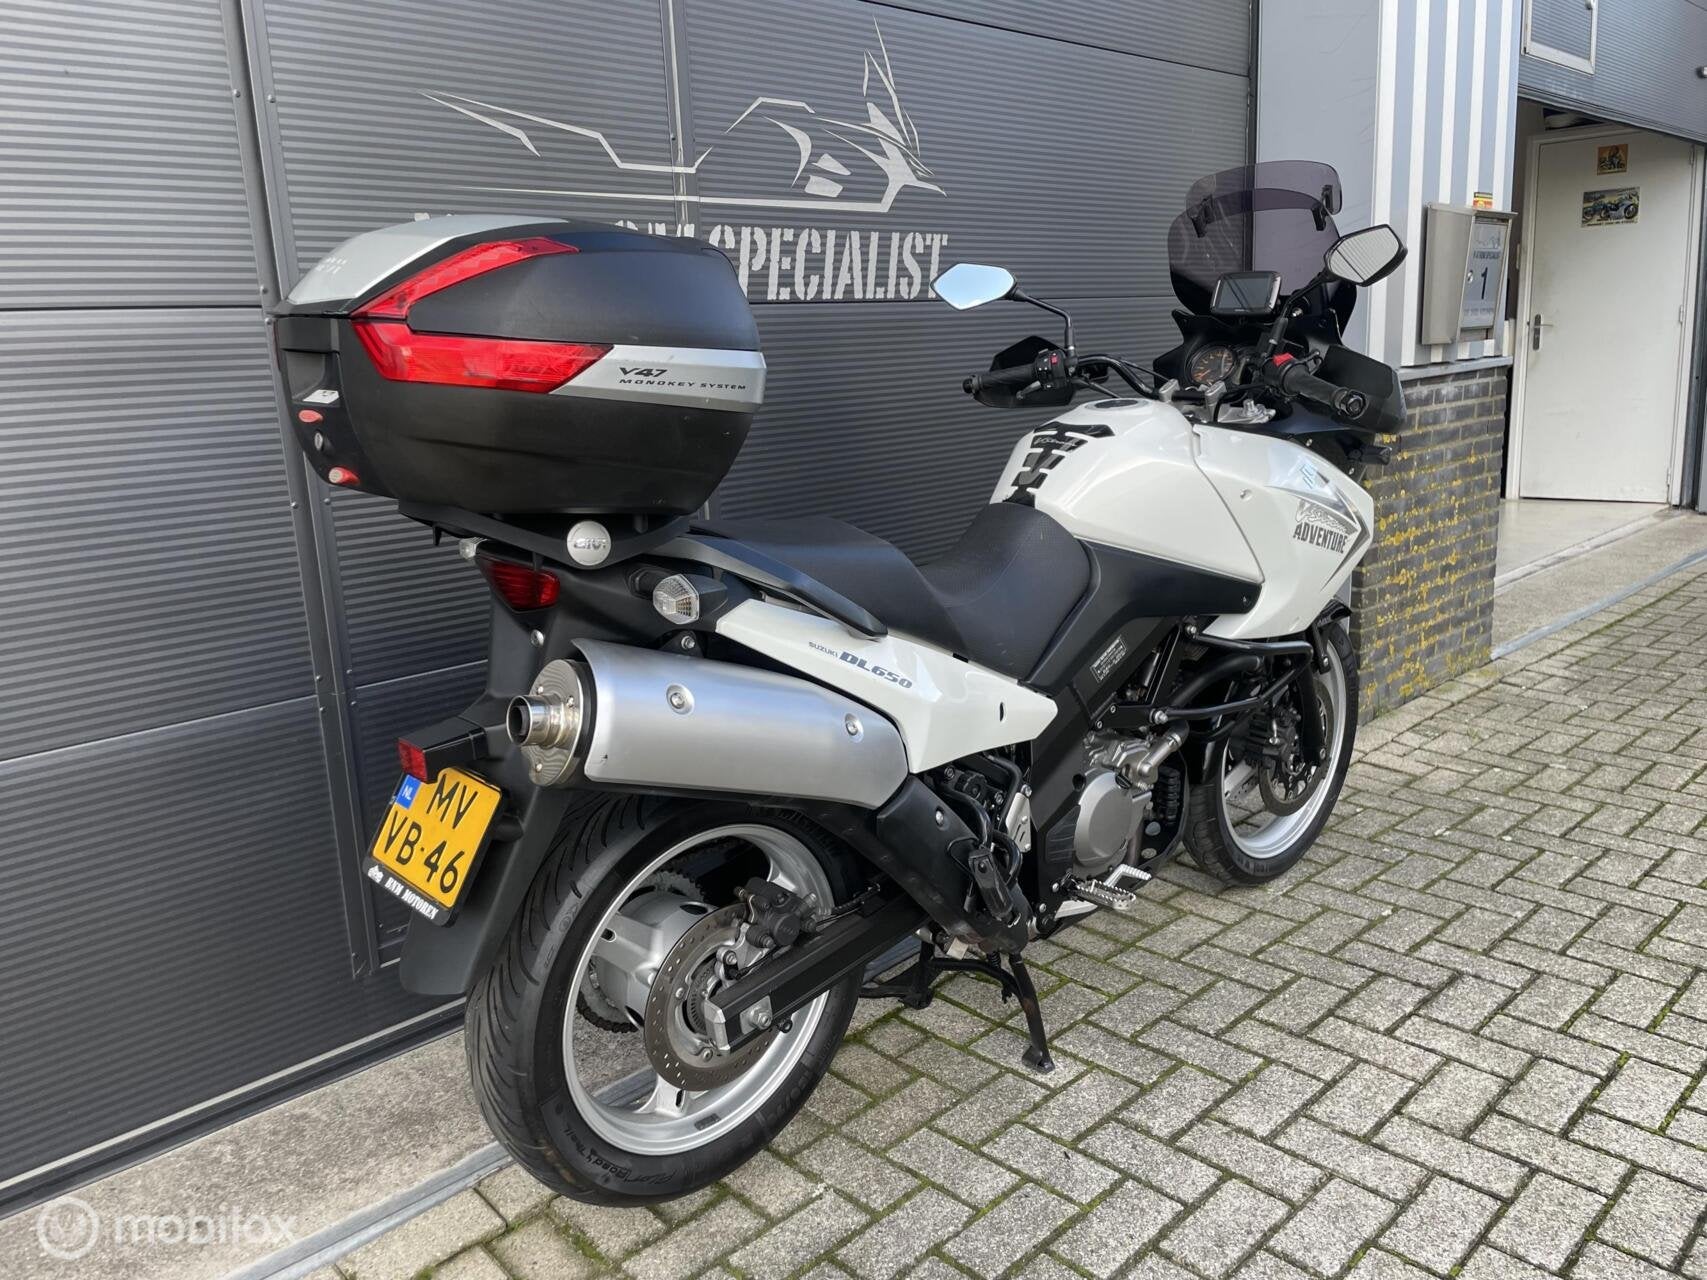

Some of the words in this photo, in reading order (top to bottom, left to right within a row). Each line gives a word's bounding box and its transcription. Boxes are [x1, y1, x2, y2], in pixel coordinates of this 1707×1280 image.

[1481, 266, 1488, 300] 1
[619, 367, 668, 377] V47
[619, 379, 695, 387] MONOKEY
[1293, 521, 1348, 554] ADVENTURE
[808, 641, 838, 658] SUZUKI
[839, 651, 913, 689] DL650
[404, 785, 412, 800] NL
[426, 773, 479, 830] MV
[383, 810, 465, 893] VB-46
